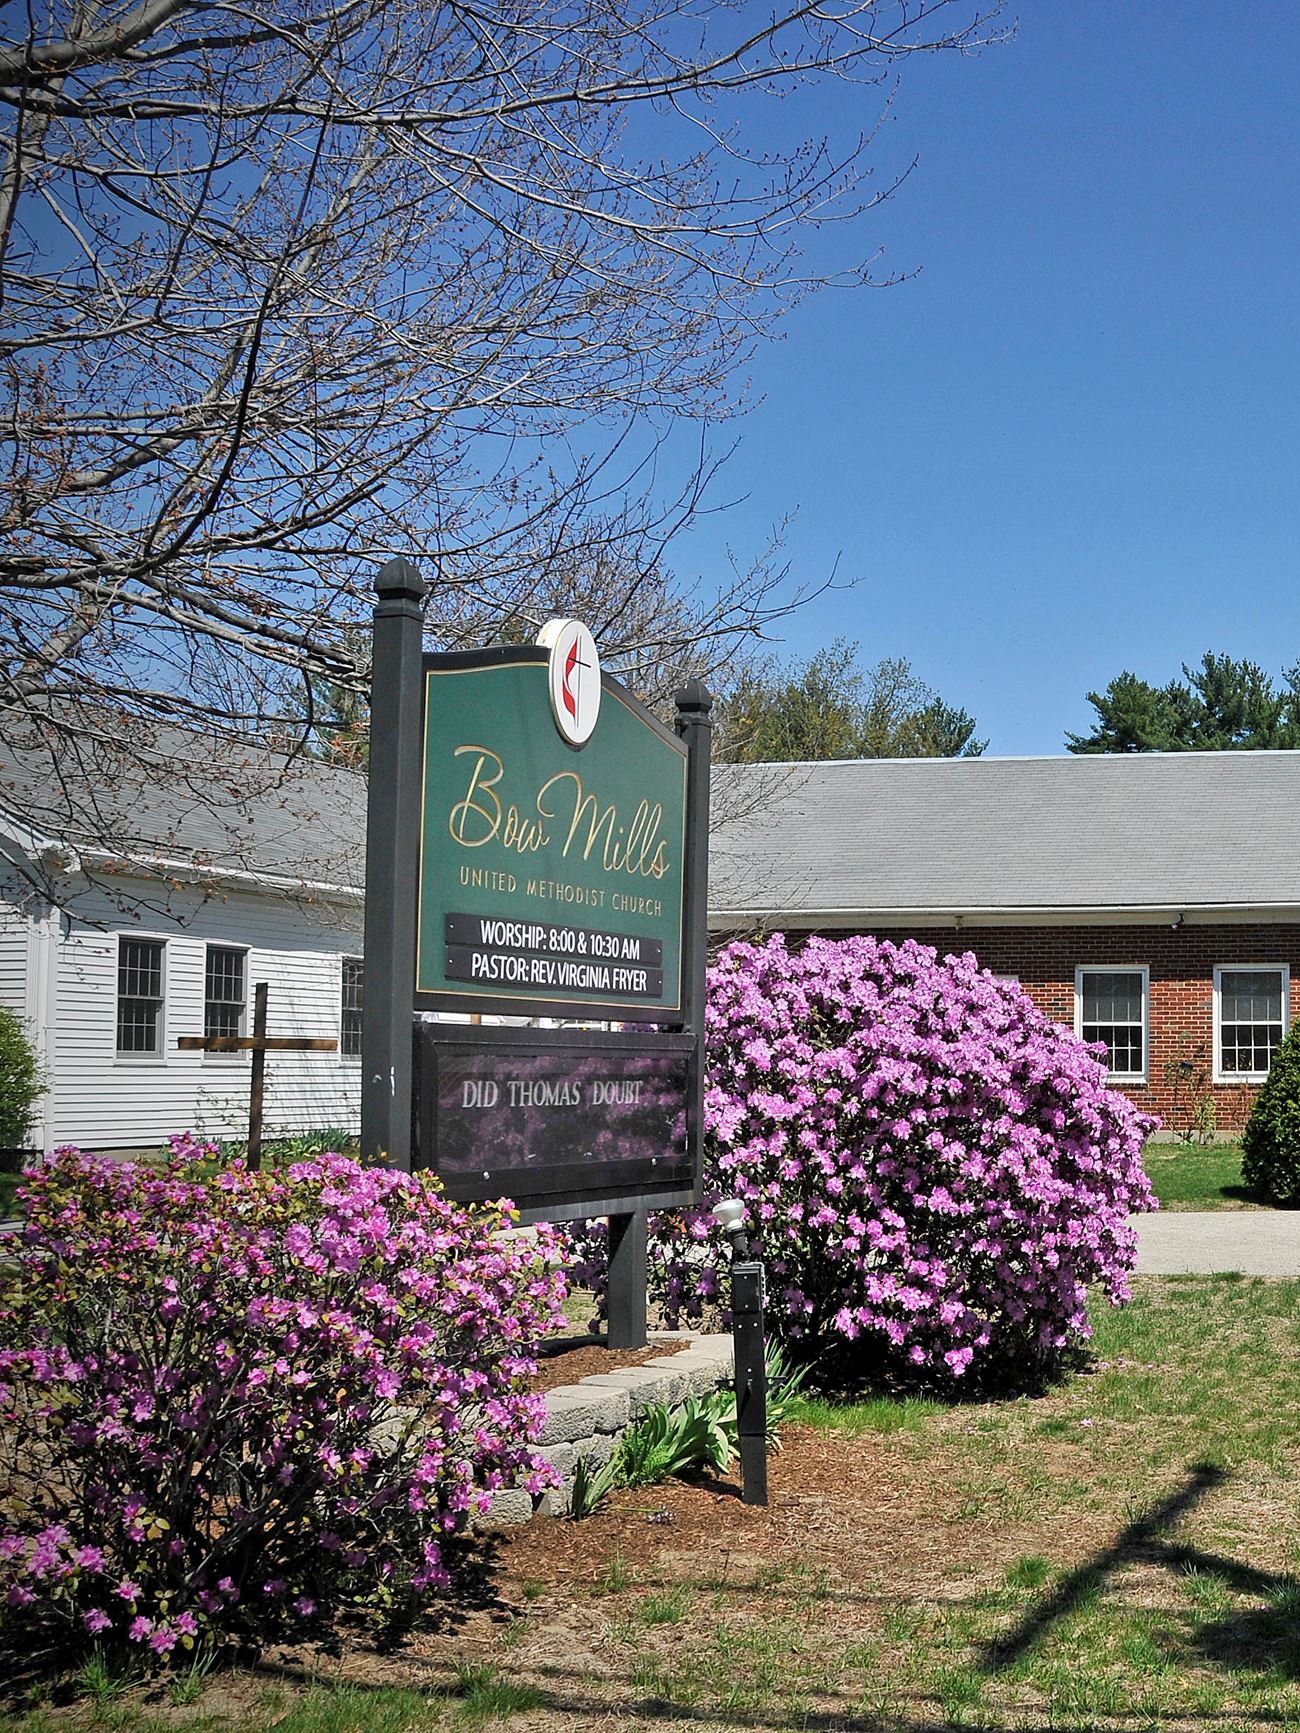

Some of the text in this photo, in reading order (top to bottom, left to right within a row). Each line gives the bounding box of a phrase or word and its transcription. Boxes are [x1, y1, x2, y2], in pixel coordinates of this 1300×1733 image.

[449, 744, 671, 880] Bow Mills
[459, 866, 662, 917] UNITED METHODIST CHURCH
[480, 919, 640, 960] WORSHIP: 8:00 & 10:30 AM
[471, 953, 530, 982] PASTOR:
[557, 962, 611, 990] VIRGINIA
[612, 968, 647, 991] FRYER
[462, 1079, 643, 1108] DID THOMAS DOUBT
